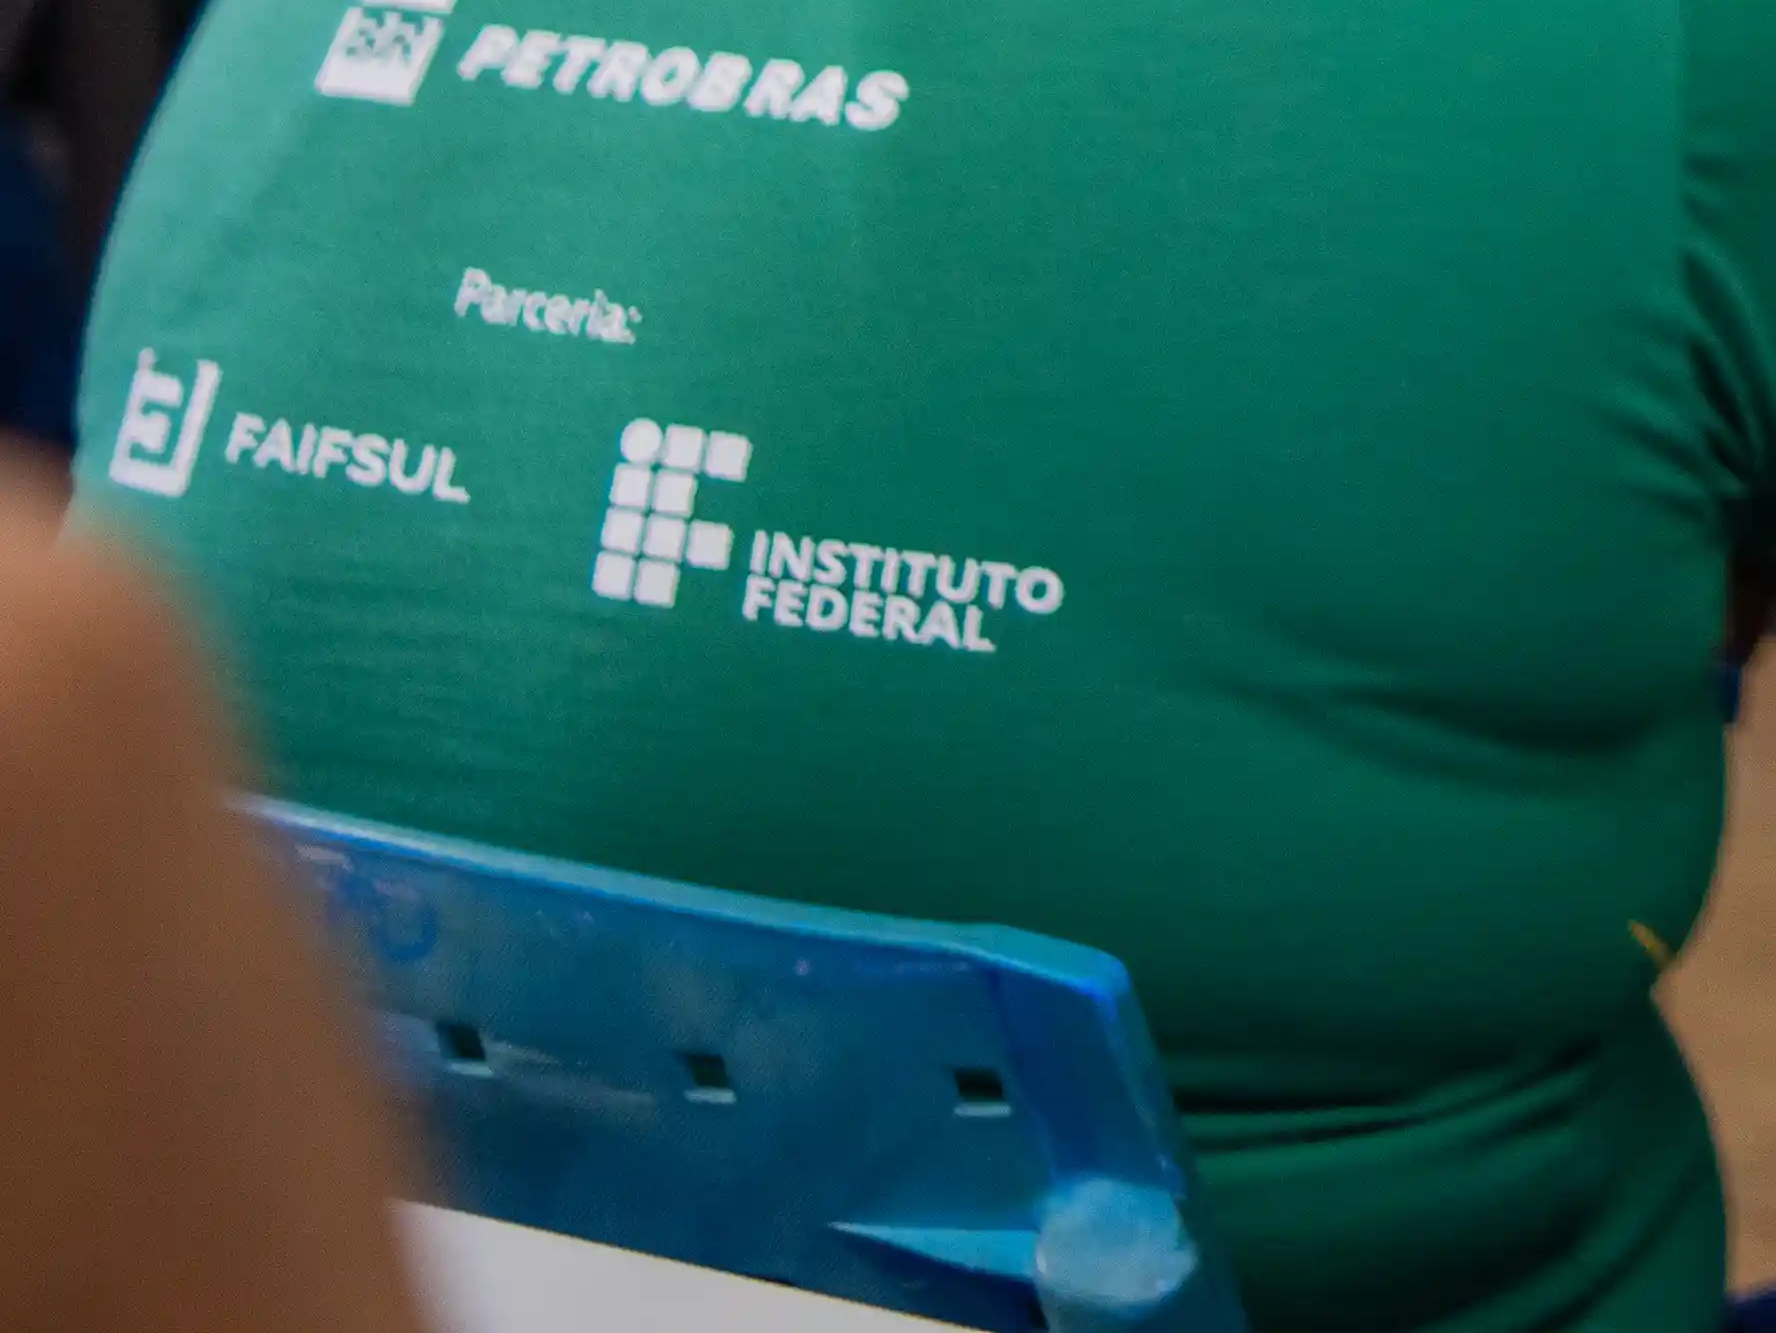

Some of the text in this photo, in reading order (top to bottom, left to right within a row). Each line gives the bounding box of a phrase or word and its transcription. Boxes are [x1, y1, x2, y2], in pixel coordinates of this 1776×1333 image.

[457, 24, 908, 130] PETROBRAS
[454, 267, 642, 344] Parceria:
[225, 412, 470, 504] FAIFSUL
[742, 574, 996, 653] FEDERAL
[750, 529, 1064, 614] INSTITUTO
